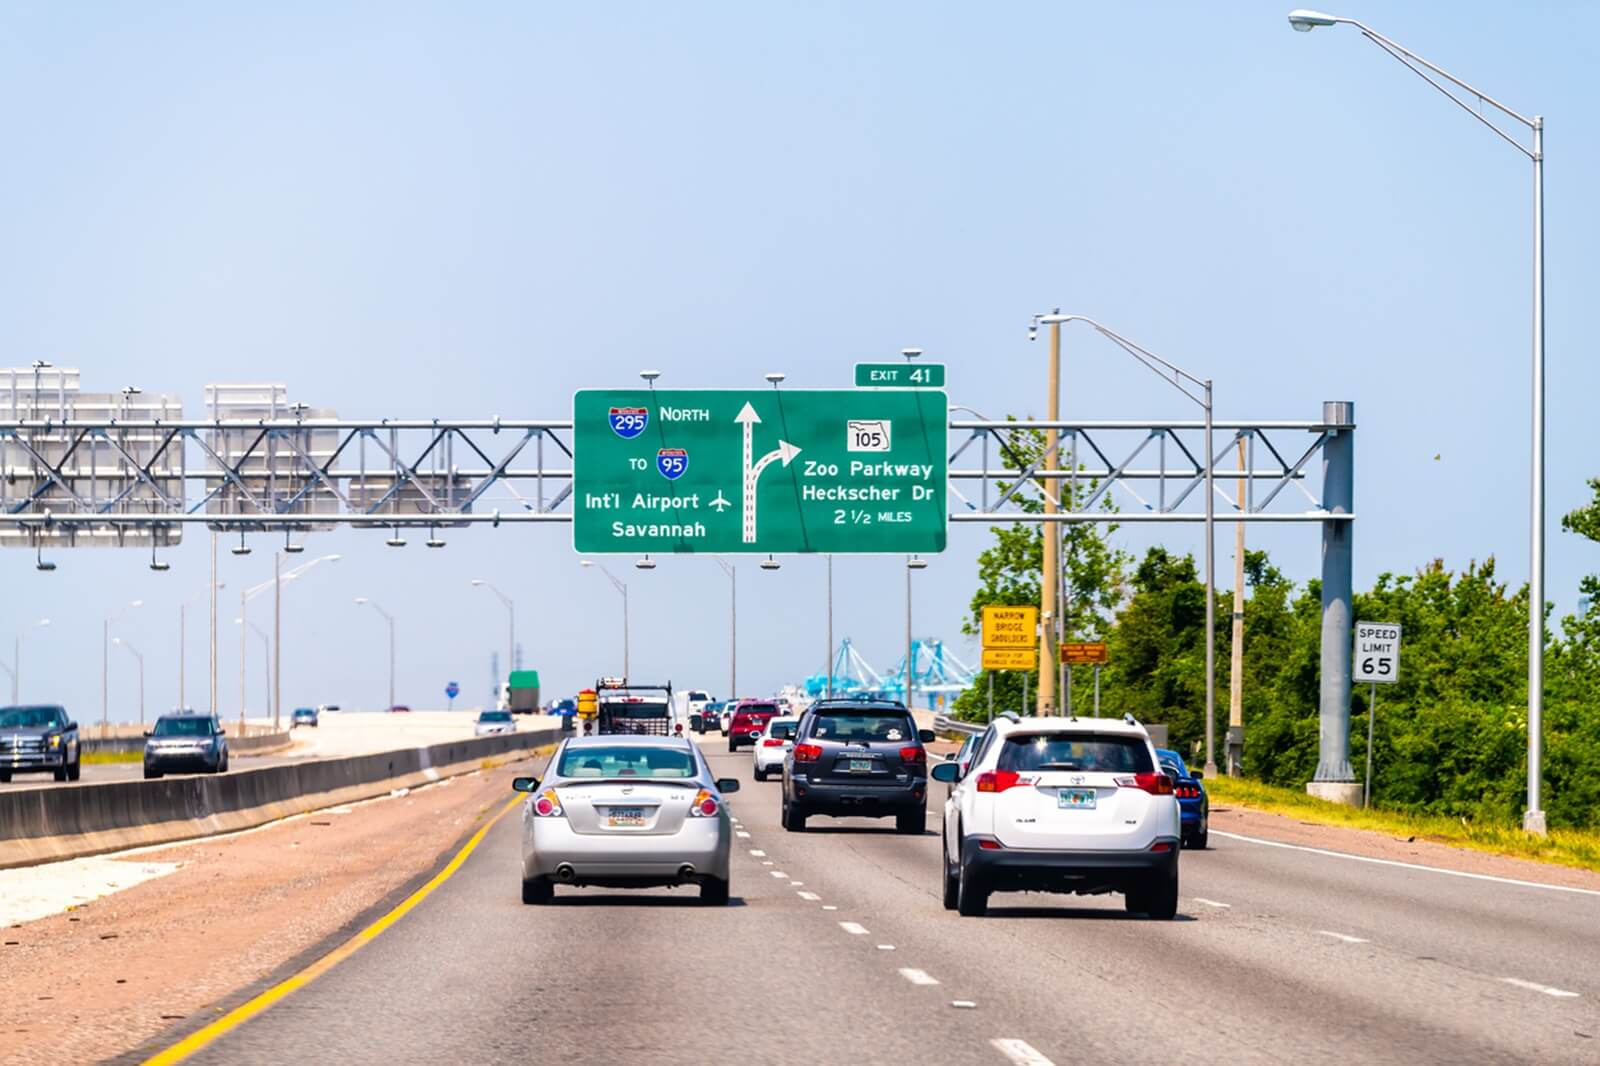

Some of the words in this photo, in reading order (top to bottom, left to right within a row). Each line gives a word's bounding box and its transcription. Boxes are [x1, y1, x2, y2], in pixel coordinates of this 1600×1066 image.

[870, 370, 898, 381] EXIT
[909, 369, 930, 383] 41
[659, 406, 710, 421] NORTH
[615, 415, 644, 430] 295
[856, 432, 881, 447] 105
[629, 458, 648, 470] TO
[662, 458, 683, 472] 95
[803, 461, 839, 476] Zoo
[851, 461, 933, 480] Parkway
[802, 485, 900, 500] Heckscher
[912, 485, 935, 500] Dr
[585, 493, 620, 508] Int'l
[632, 493, 699, 512] Airport
[833, 509, 846, 524] 2
[877, 511, 913, 522] MILES
[612, 521, 706, 537] Savannah
[1359, 628, 1397, 639] SPEED
[1362, 643, 1392, 653] LIMIT
[1362, 657, 1391, 675] 65
